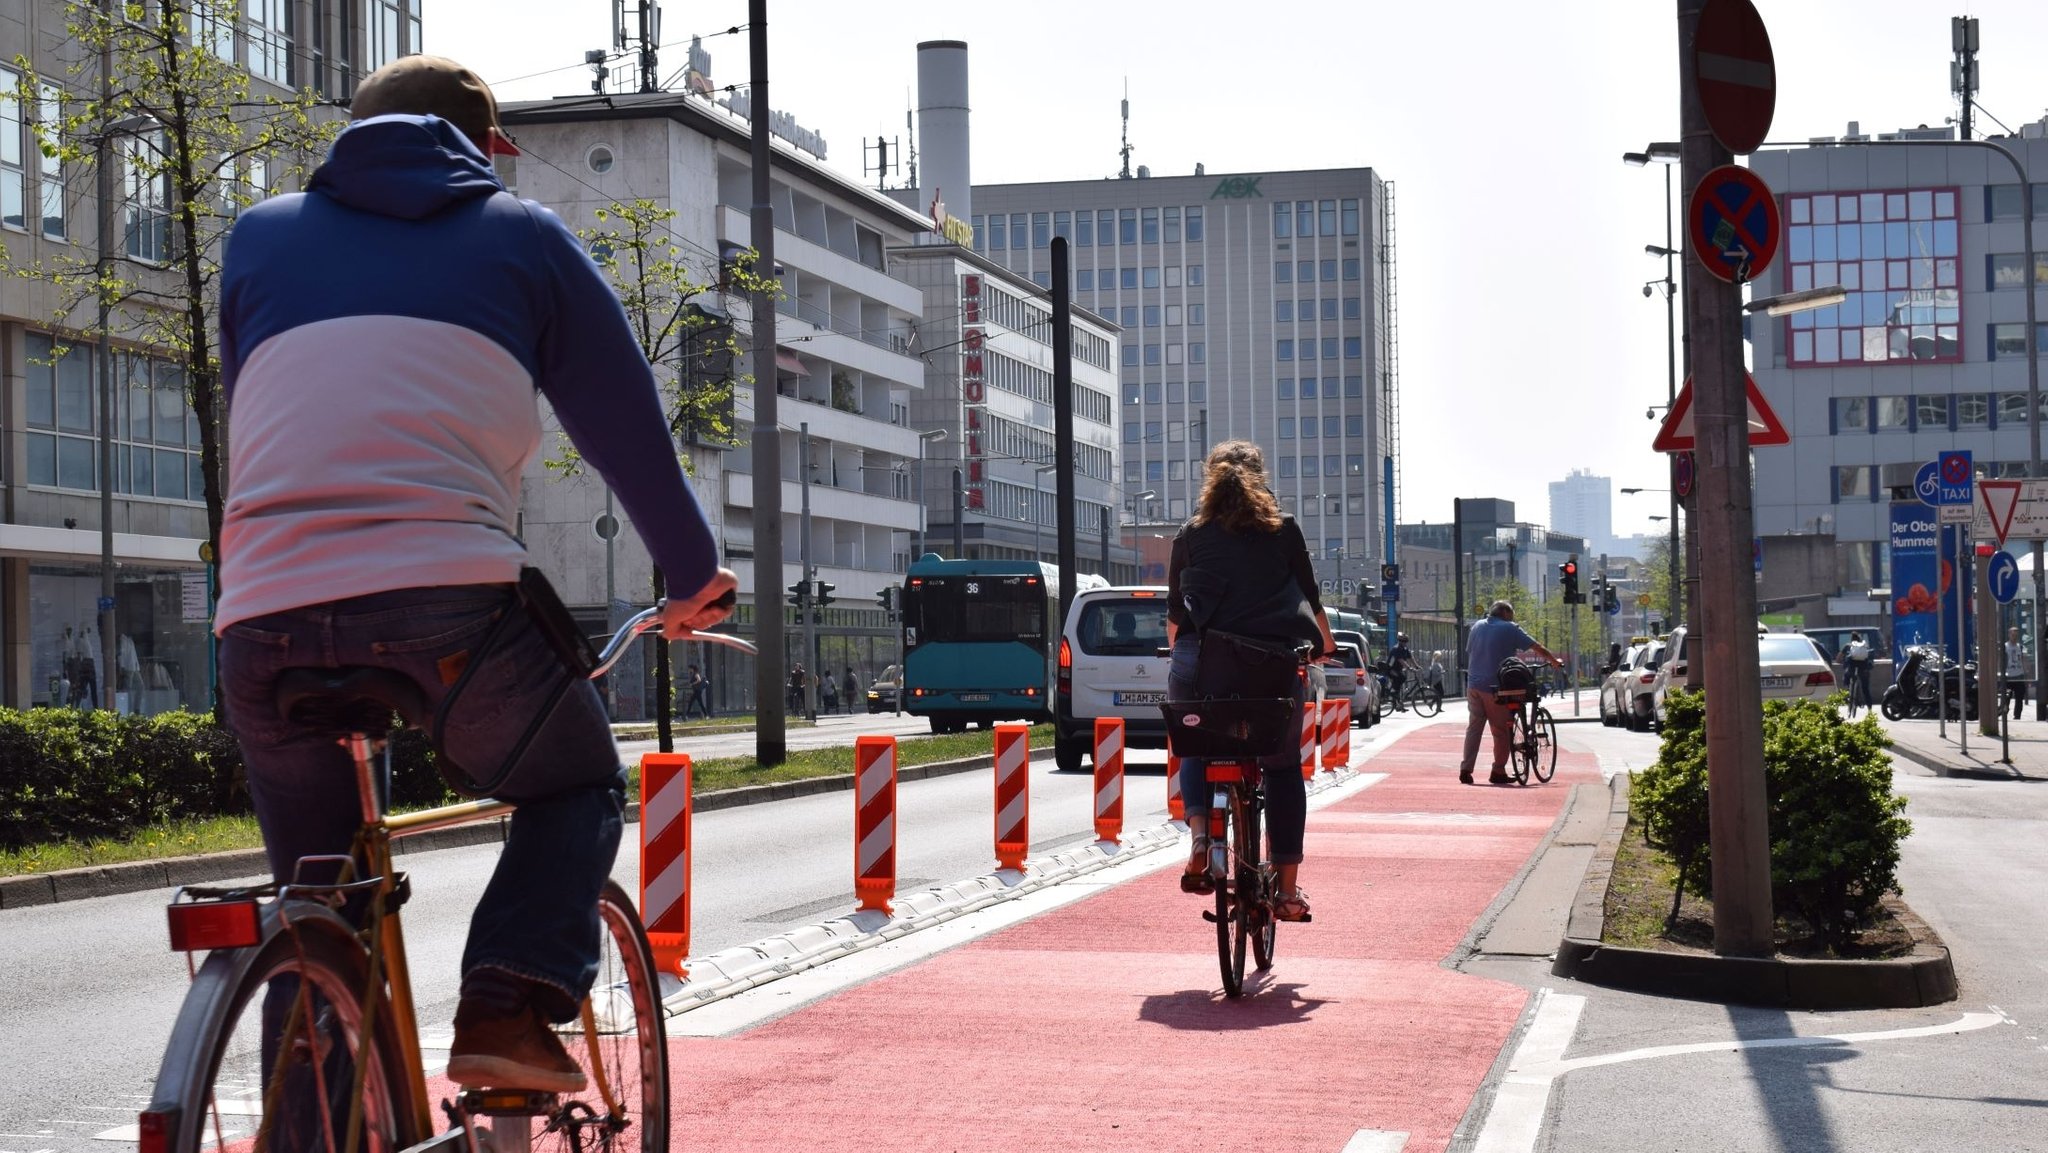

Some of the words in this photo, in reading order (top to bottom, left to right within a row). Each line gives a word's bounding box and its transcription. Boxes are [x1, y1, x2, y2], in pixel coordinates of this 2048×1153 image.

[1210, 176, 1263, 200] AOK
[1942, 487, 1970, 500] TAXI
[1892, 522, 1907, 533] Der
[966, 583, 979, 594] 36
[1119, 694, 1131, 703] LM
[1137, 694, 1148, 703] AM
